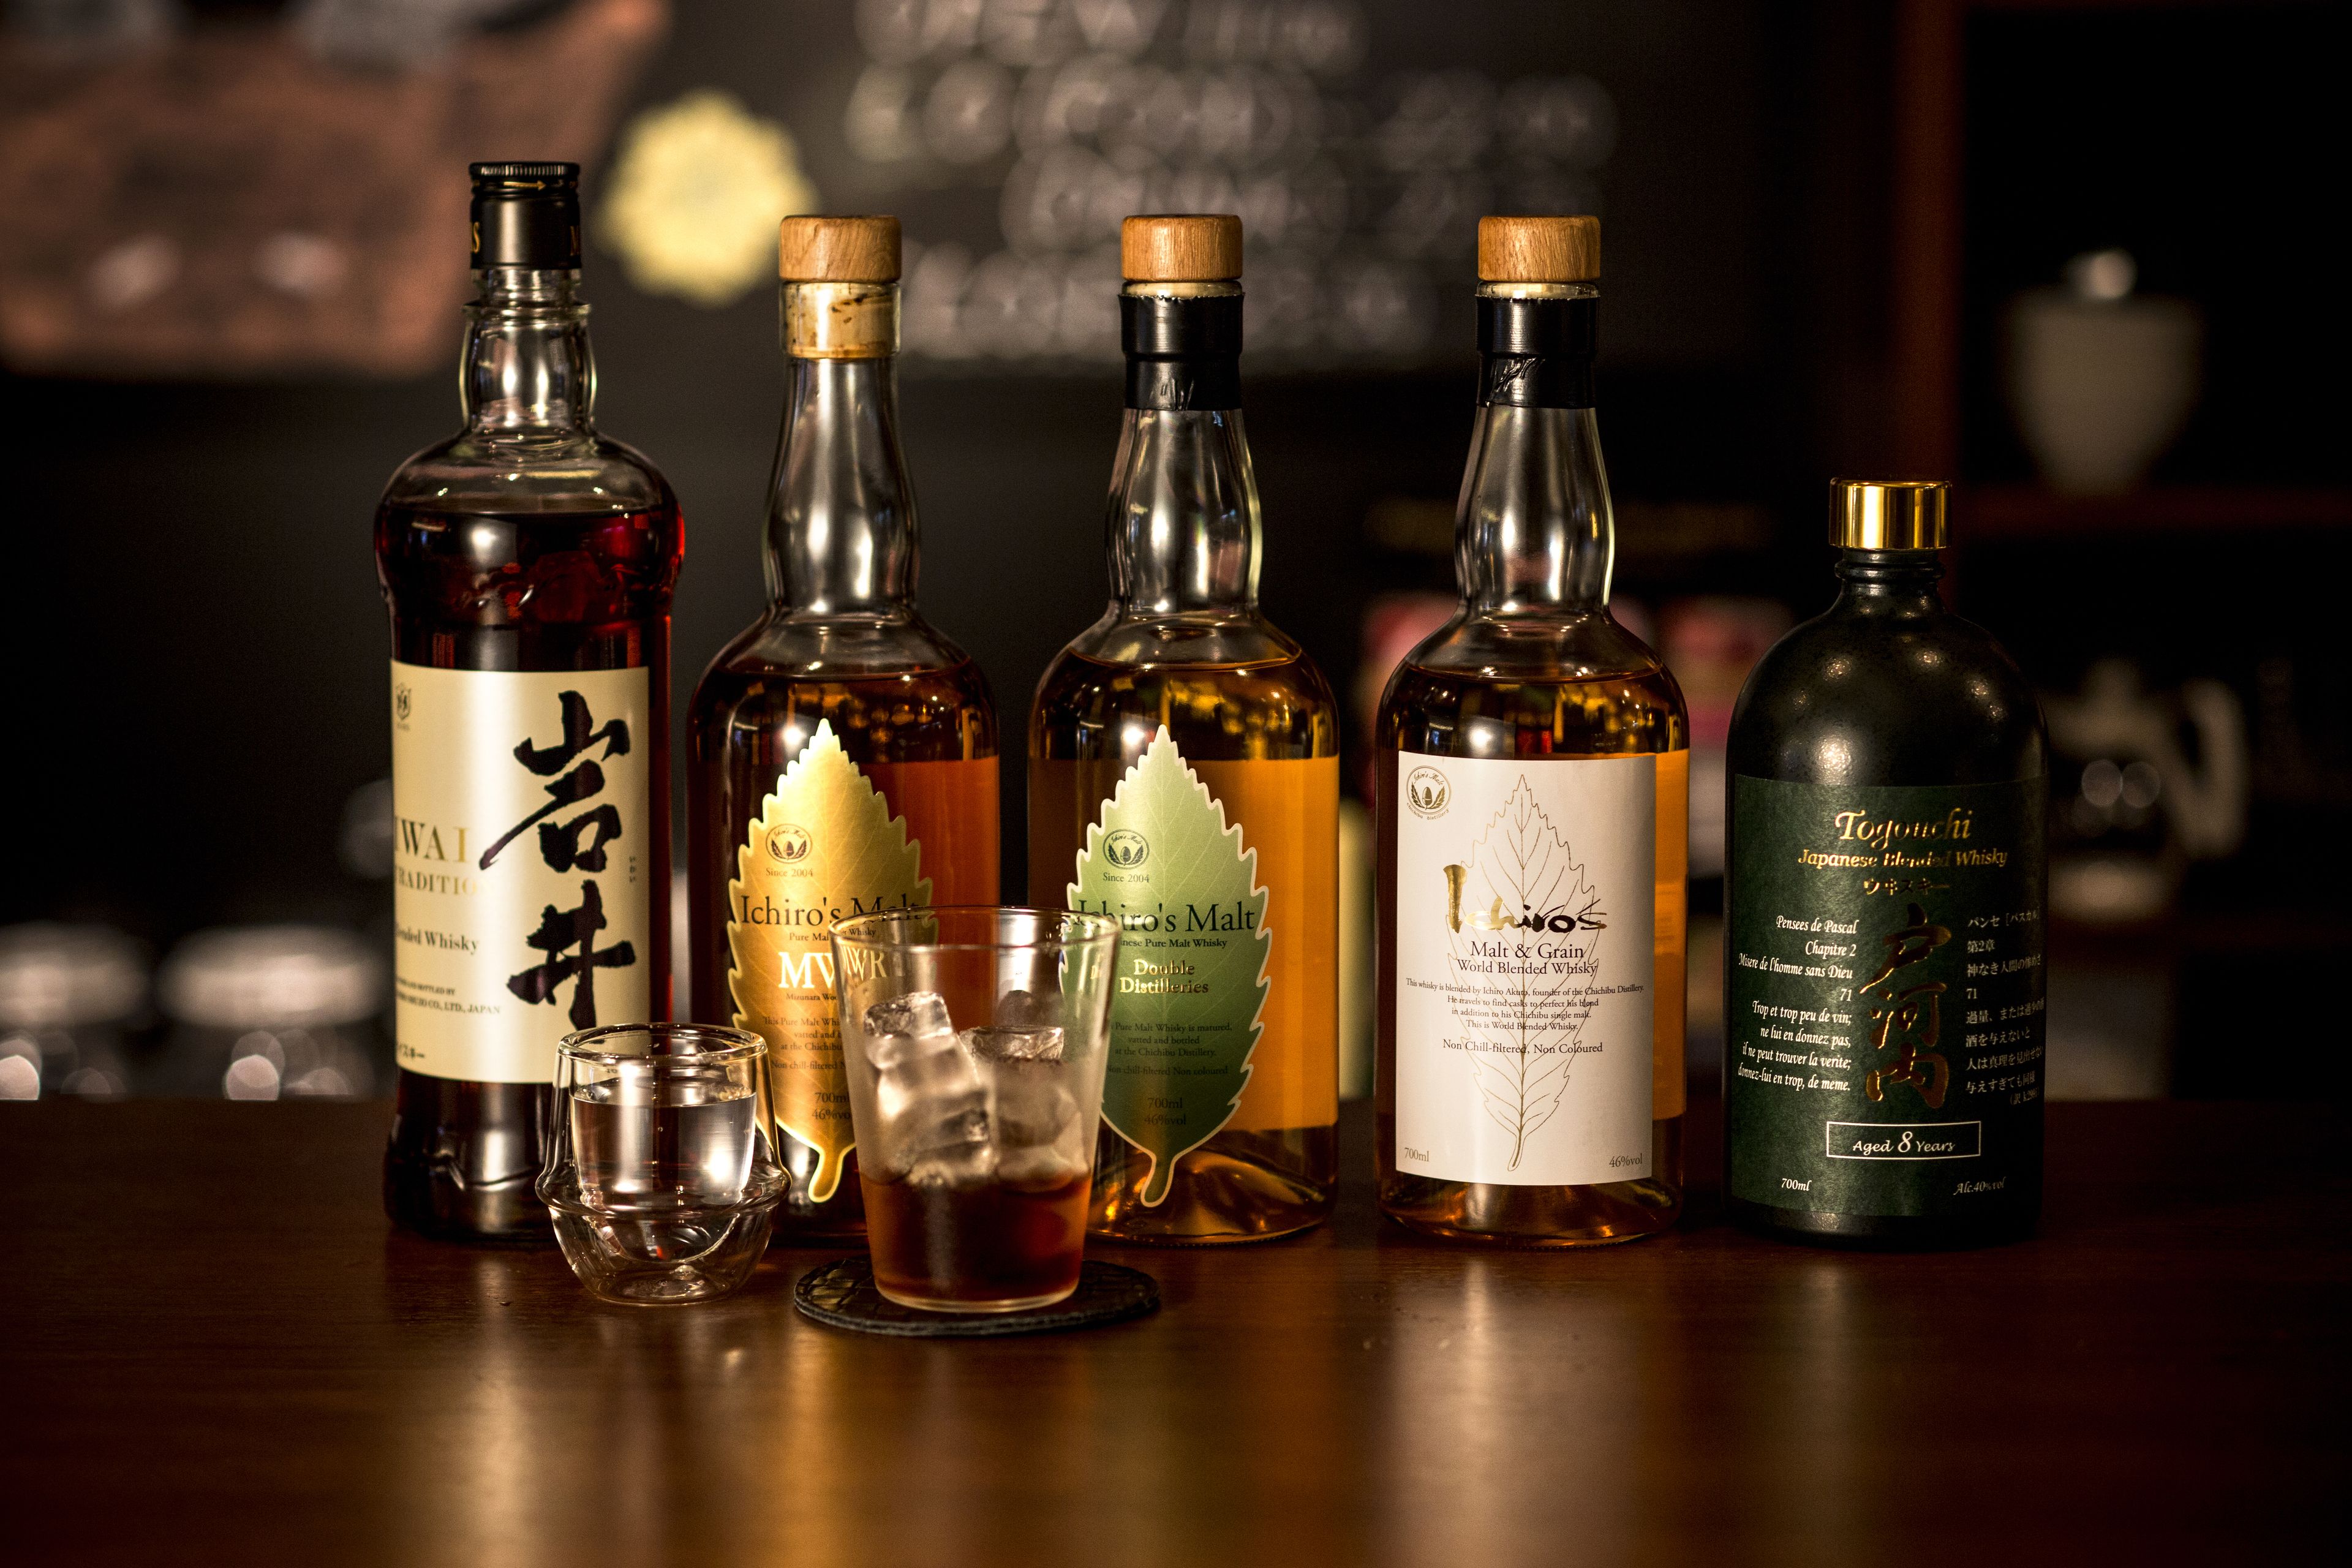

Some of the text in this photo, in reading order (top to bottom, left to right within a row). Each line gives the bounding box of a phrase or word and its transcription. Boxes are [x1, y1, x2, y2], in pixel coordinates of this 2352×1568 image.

[1834, 807, 1973, 851] Togouchi
[479, 690, 636, 1044] 岩井
[1798, 848, 2008, 869] Japanese Blended Whisky
[766, 867, 813, 878] Since 2004
[1102, 872, 1150, 883] Since 2004
[741, 895, 841, 926] Ichiro's
[1185, 900, 1255, 932] Malt
[1776, 914, 1860, 934] Pensees de Pascal
[789, 932, 809, 941] Pure
[812, 932, 830, 941] Mal
[848, 927, 876, 938] Whisky
[424, 930, 479, 956] Whisky
[1145, 938, 1228, 949] Pure Malt Whisky
[1470, 941, 1585, 959] Malt & Grain
[1805, 940, 1857, 960] Chapitre 2
[1133, 959, 1195, 976] Double
[1457, 959, 1598, 977] World Blended Whisky
[1738, 952, 1853, 979] Misere de l'homme sans Dieu
[1119, 976, 1209, 994] Distilleries
[1406, 977, 1417, 987] This
[1418, 980, 1438, 992] whisky
[1445, 983, 1471, 993] blended
[1472, 986, 1481, 996] by
[1483, 987, 1504, 995] Ichiro
[1532, 988, 1561, 997] founder
[1585, 986, 1616, 996] Chichibu
[1617, 983, 1645, 994] Distillery.
[1966, 987, 1977, 1000] 71
[786, 992, 821, 1001] Mizunara
[1459, 997, 1481, 1006] travels
[1491, 998, 1507, 1007] find
[1539, 1000, 1565, 1009] perfect
[1566, 999, 1578, 1008] his
[1579, 998, 1599, 1008] blend
[1840, 988, 1853, 1002] 71
[781, 1017, 798, 1026] Pure
[801, 1017, 820, 1027] Malt
[1460, 1008, 1490, 1017] addition
[1513, 1011, 1549, 1019] Chichibu
[1550, 1011, 1572, 1021] single
[1752, 1000, 1852, 1027] Trop et trop peu de vin;
[1115, 1022, 1132, 1031] Pure
[1155, 1023, 1186, 1035] Whisky
[1465, 1019, 1482, 1028] This
[1491, 1020, 1514, 1030] World
[1517, 1022, 1547, 1031] Blended
[1548, 1022, 1578, 1032] Whisky.
[1170, 1035, 1200, 1045] bottled
[1760, 1024, 1851, 1050] ne lui en donnez pas,
[1442, 1038, 1603, 1055] Non Chill-filtered, Non Coloured
[1742, 1041, 1852, 1071] il ne peut trouver la verite;
[1738, 1062, 1851, 1091] donnez-lui en trop, de meme.
[812, 1108, 851, 1120] 46%vo
[1852, 1131, 1956, 1156] Aged 8 Years
[1403, 1147, 1430, 1163] 700ml
[1608, 1153, 1643, 1168] 46%vol
[1781, 1178, 1812, 1191] 700ml
